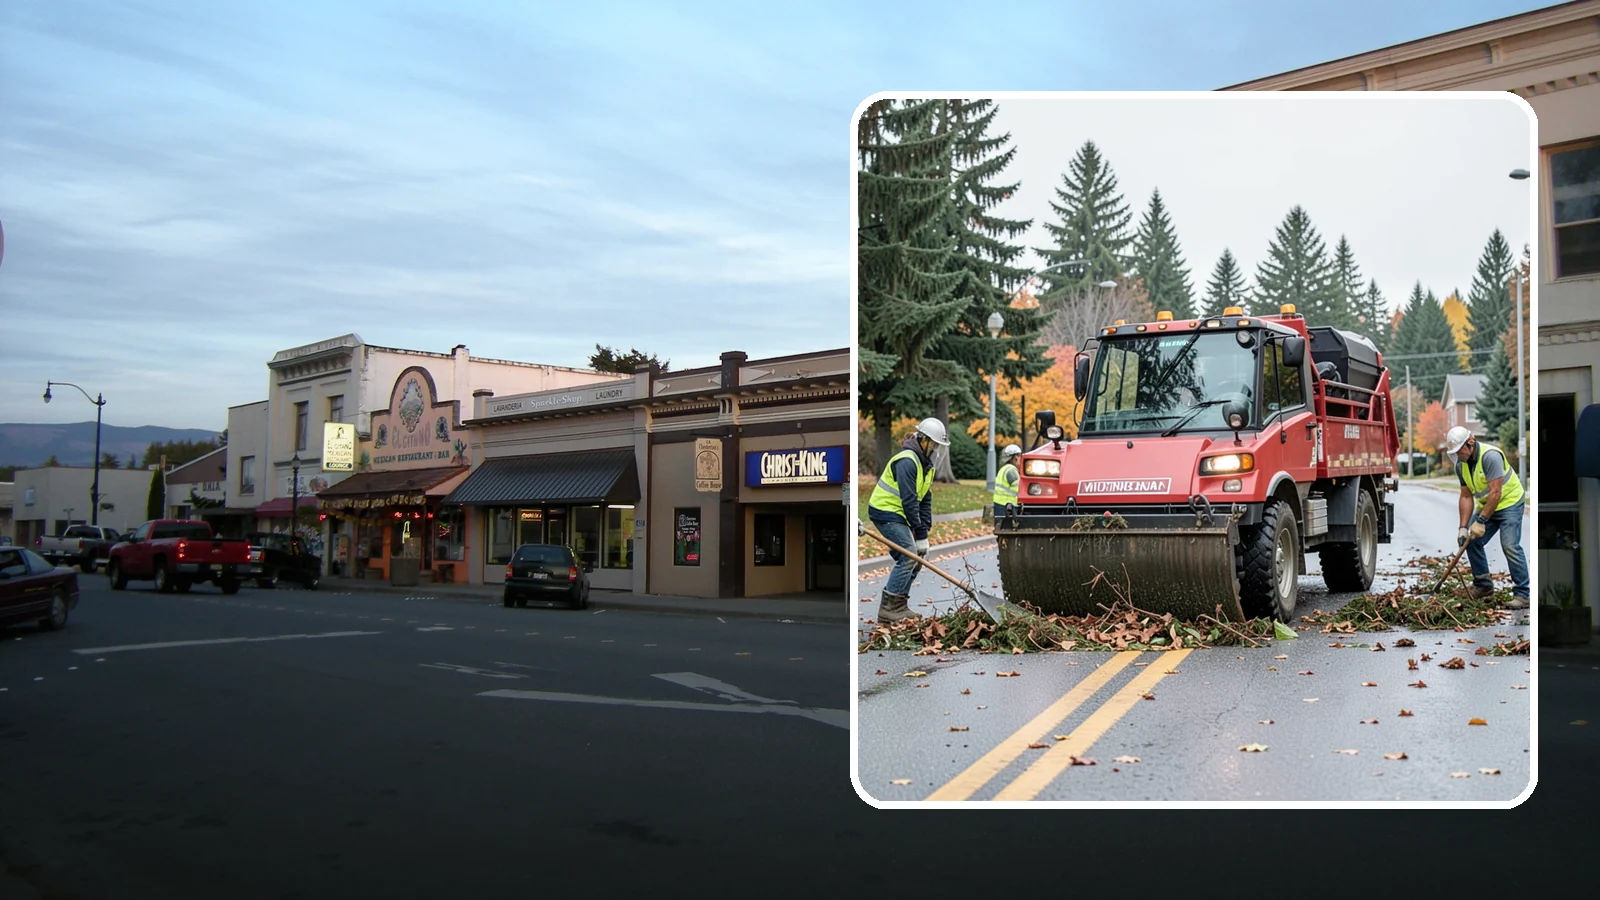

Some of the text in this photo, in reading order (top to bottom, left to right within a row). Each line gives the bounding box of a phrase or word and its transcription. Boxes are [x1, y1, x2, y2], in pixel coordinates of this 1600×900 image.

[562, 394, 582, 405] Shop
[596, 389, 623, 400] LAUNDRY
[494, 402, 522, 412] LAVANDERIA
[374, 450, 450, 464] MEXICAN RESTAURANT BAR
[760, 449, 828, 478] CHRIST KING
